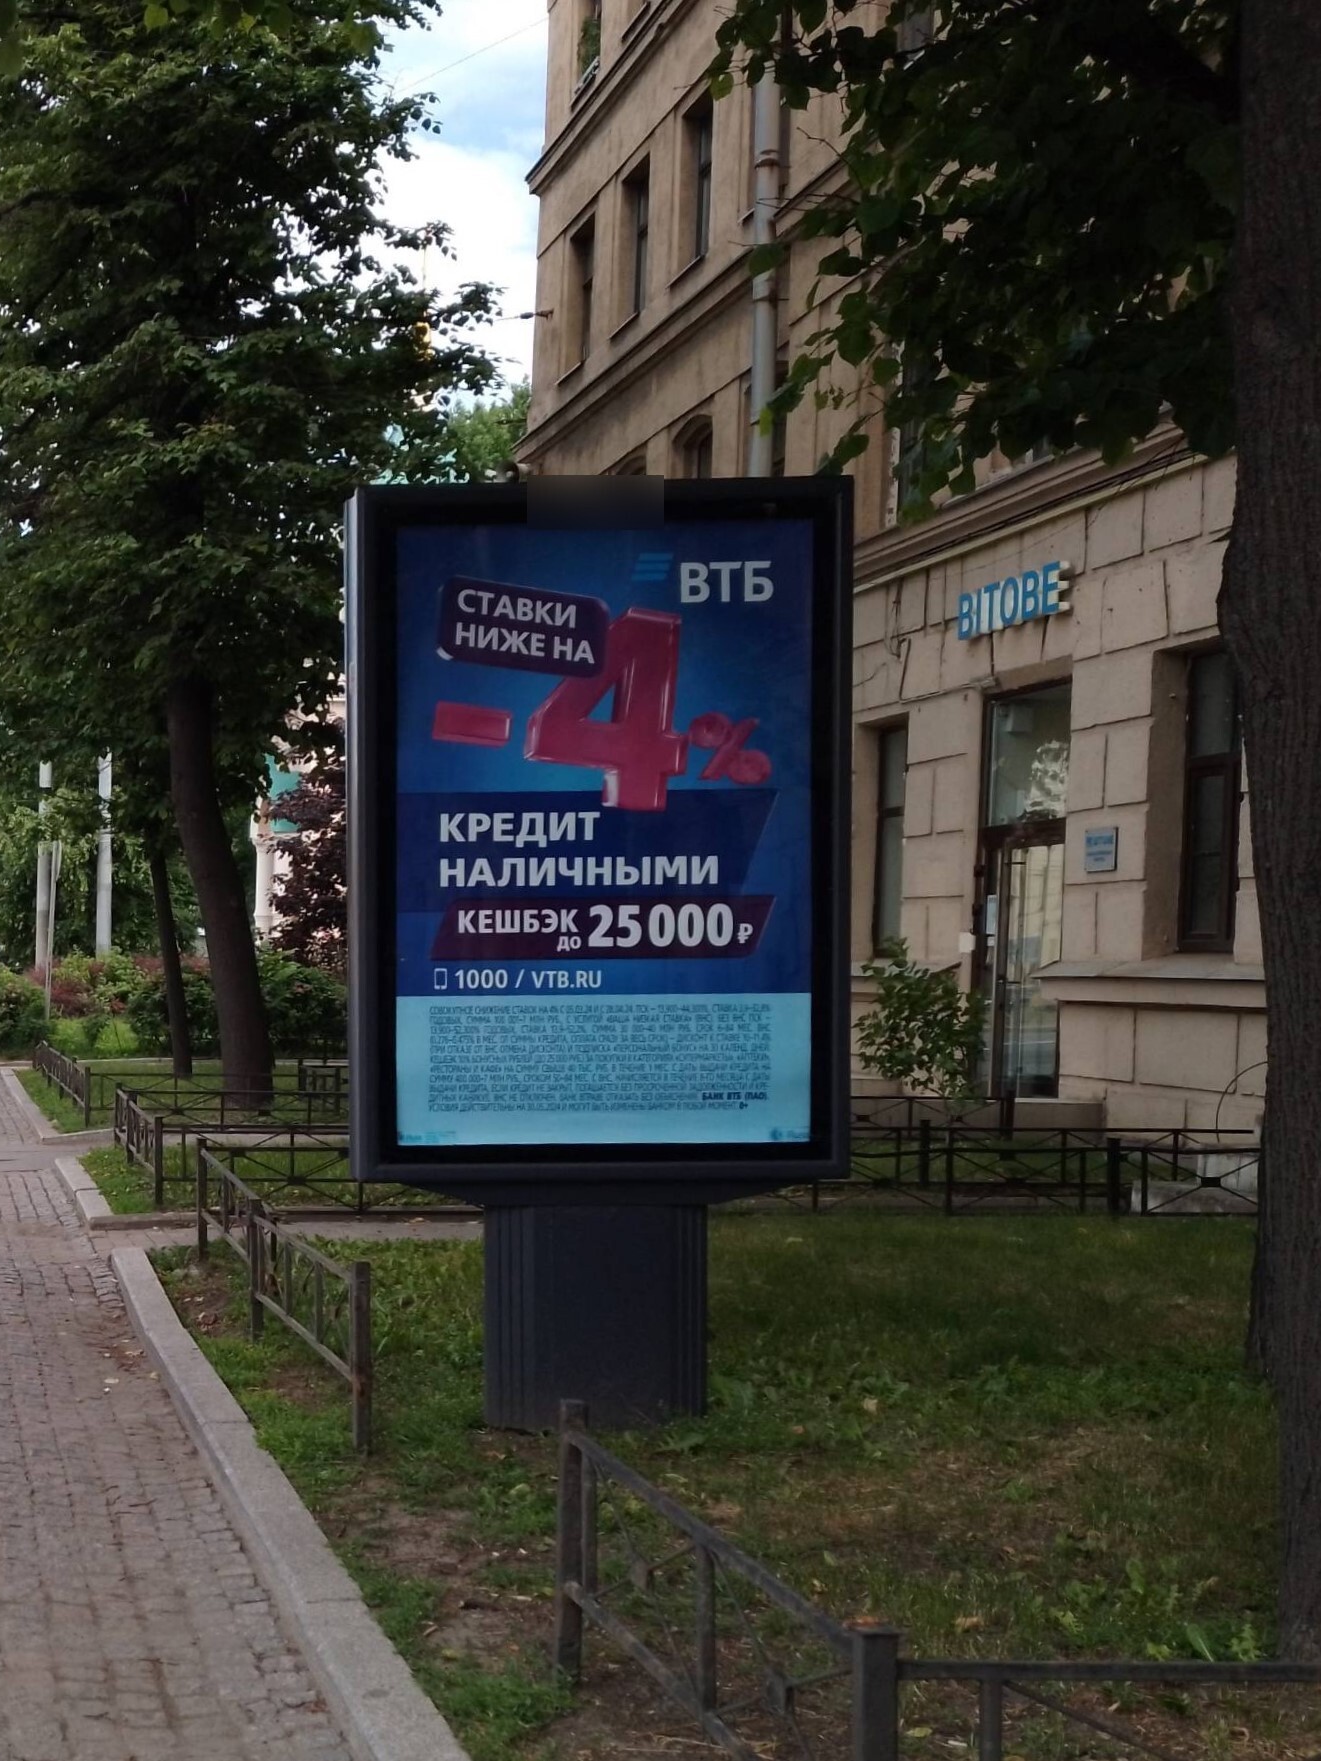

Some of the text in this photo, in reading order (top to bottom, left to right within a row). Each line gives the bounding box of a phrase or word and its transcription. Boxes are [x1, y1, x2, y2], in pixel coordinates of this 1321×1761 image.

[679, 560, 774, 604] ВТБ
[958, 561, 1061, 641] BITOBE
[457, 587, 578, 629] СТАВКИ
[454, 621, 595, 664] НИЖЕ НА
[439, 811, 601, 848] КРЕДИТ
[439, 855, 720, 887] НАЛИЧНЫМИ
[457, 908, 579, 934] КЕШБЭК
[455, 968, 508, 989] 1000
[531, 970, 602, 989] VTB.RU
